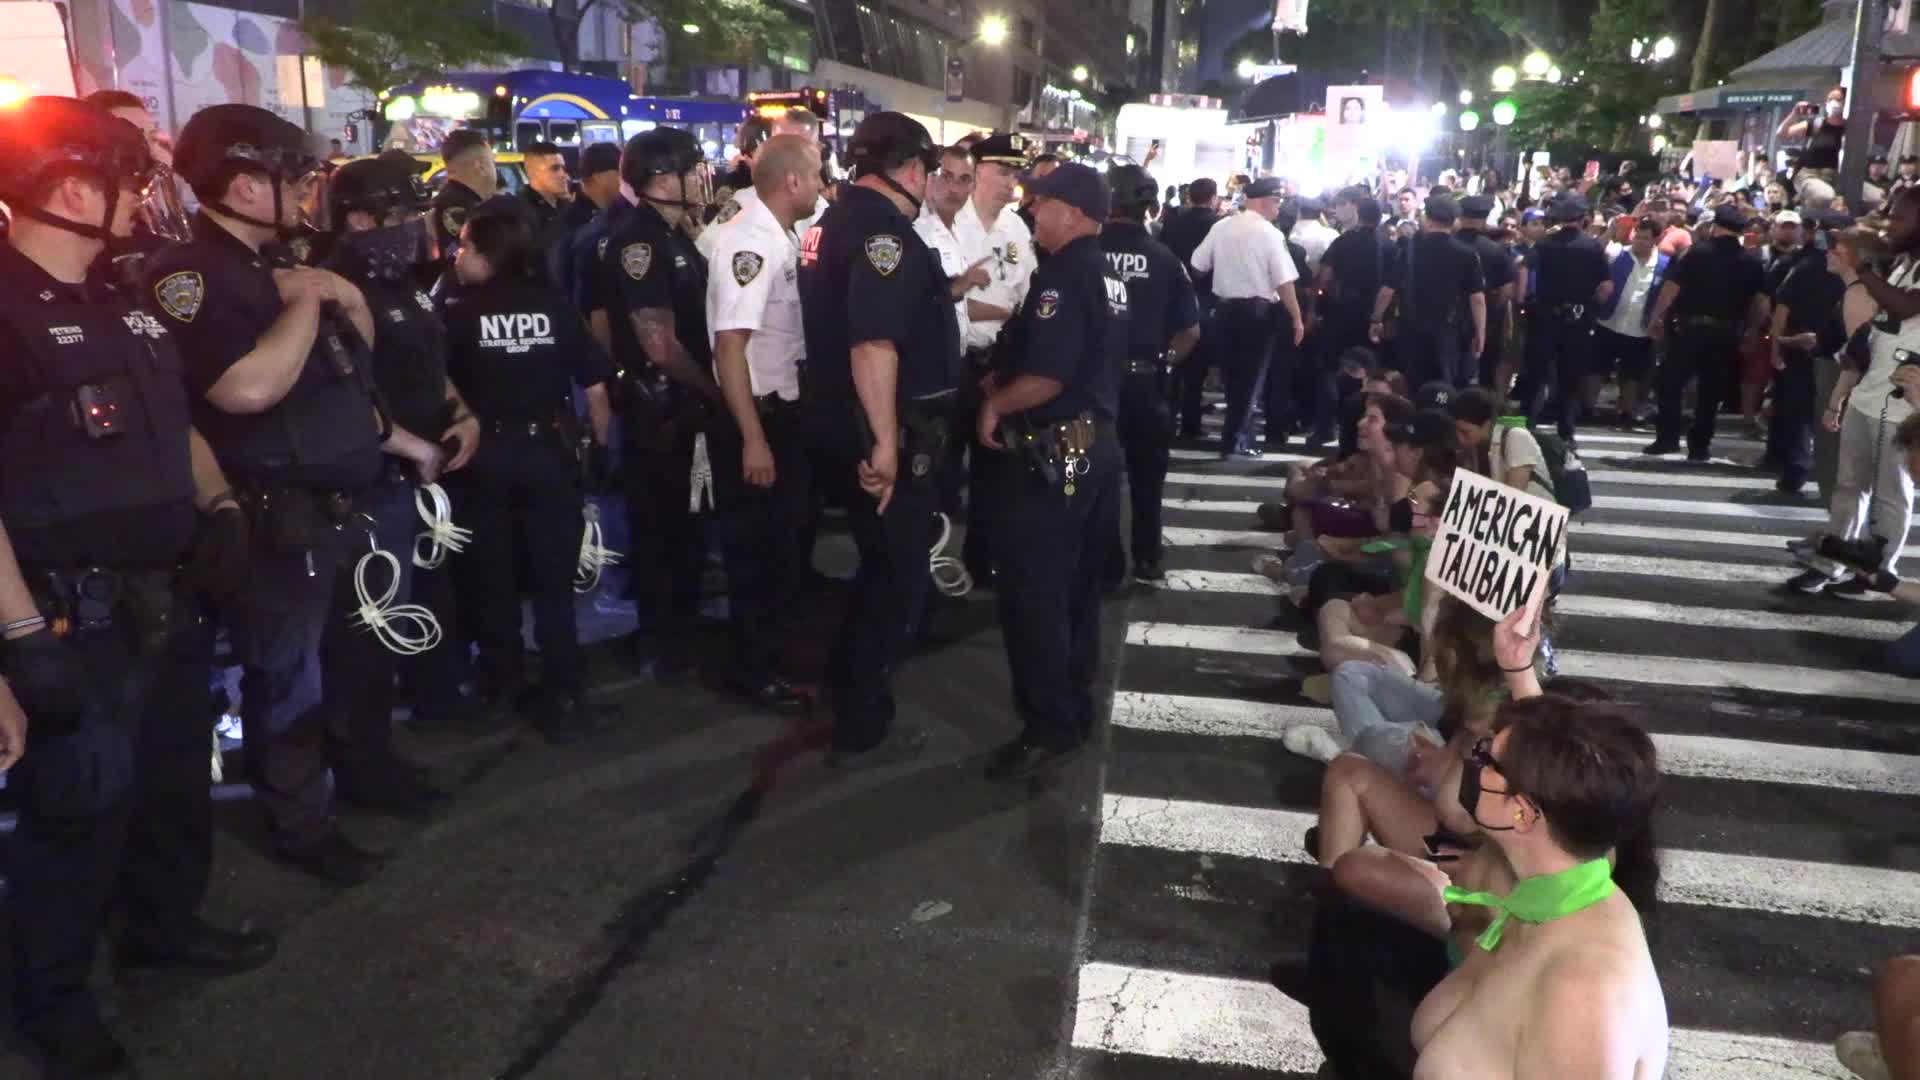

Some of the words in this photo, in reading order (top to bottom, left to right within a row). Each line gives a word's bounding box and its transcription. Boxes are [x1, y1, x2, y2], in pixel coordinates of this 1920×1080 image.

[1727, 95, 1764, 103] BRYANT
[1767, 94, 1793, 102] PARK
[480, 313, 550, 339] NYPD
[479, 339, 518, 347] STRATEGIC
[1443, 480, 1564, 571] AMERICAN
[1438, 533, 1538, 615] TALIBAN
